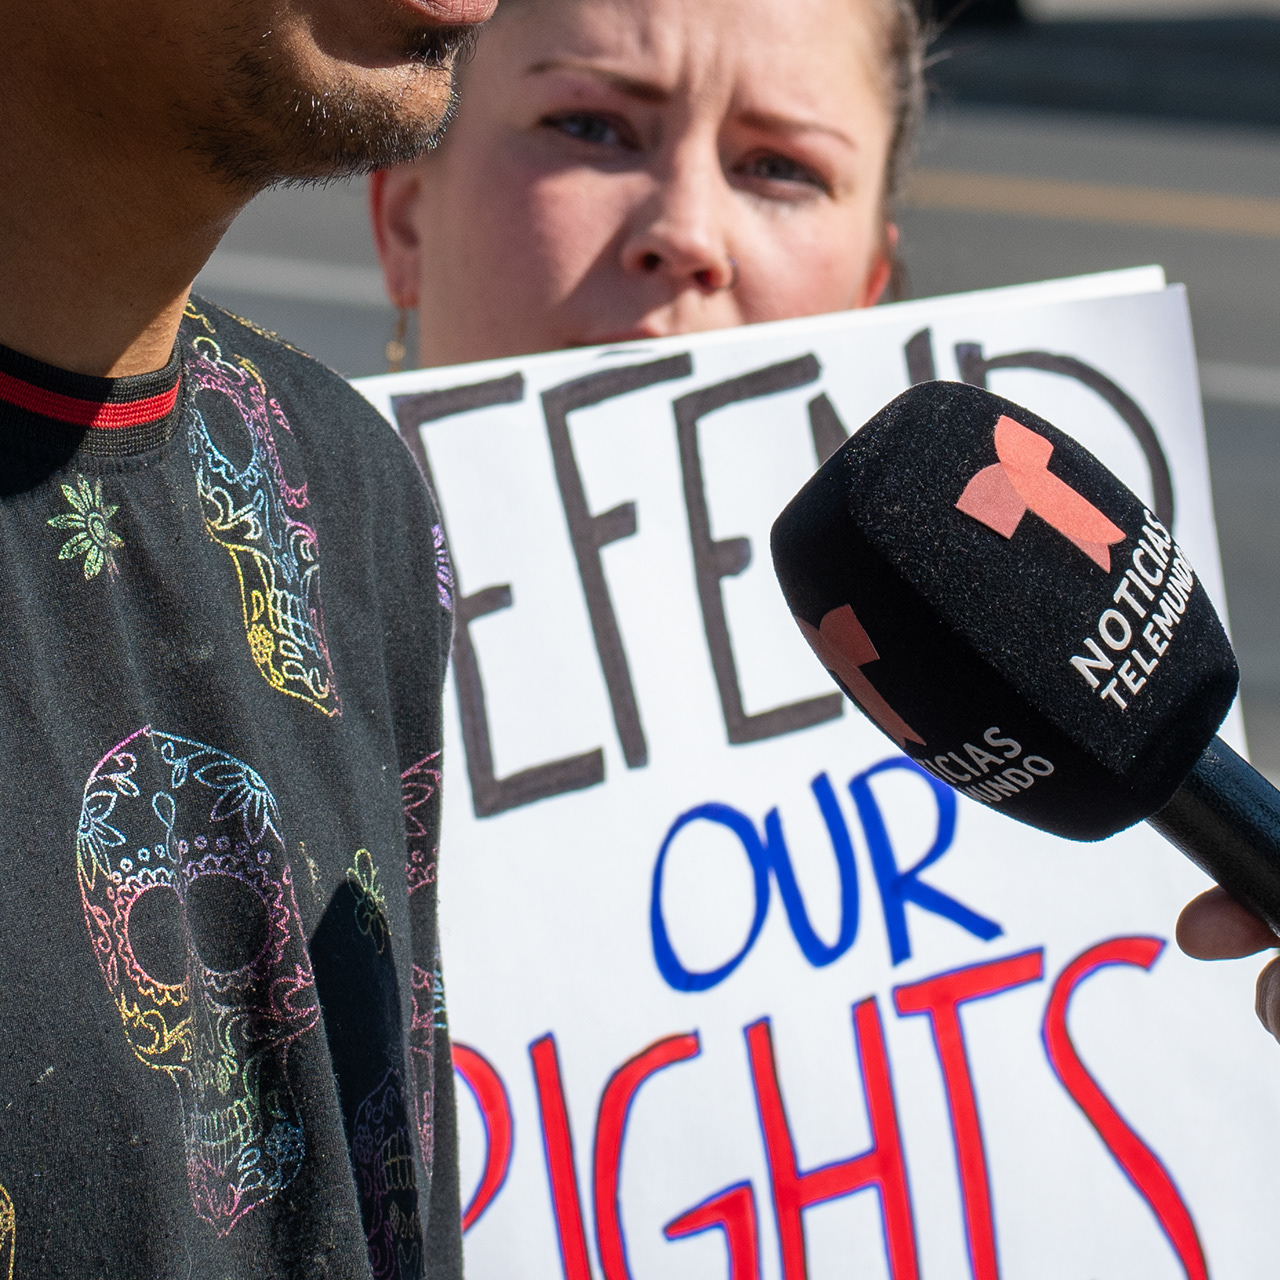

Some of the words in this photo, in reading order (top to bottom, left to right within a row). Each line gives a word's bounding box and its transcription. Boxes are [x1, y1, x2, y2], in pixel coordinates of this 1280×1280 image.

[1070, 508, 1172, 689] NOTICIAS
[1100, 545, 1195, 711] TELEMUNDO
[650, 756, 1006, 992] OUR
